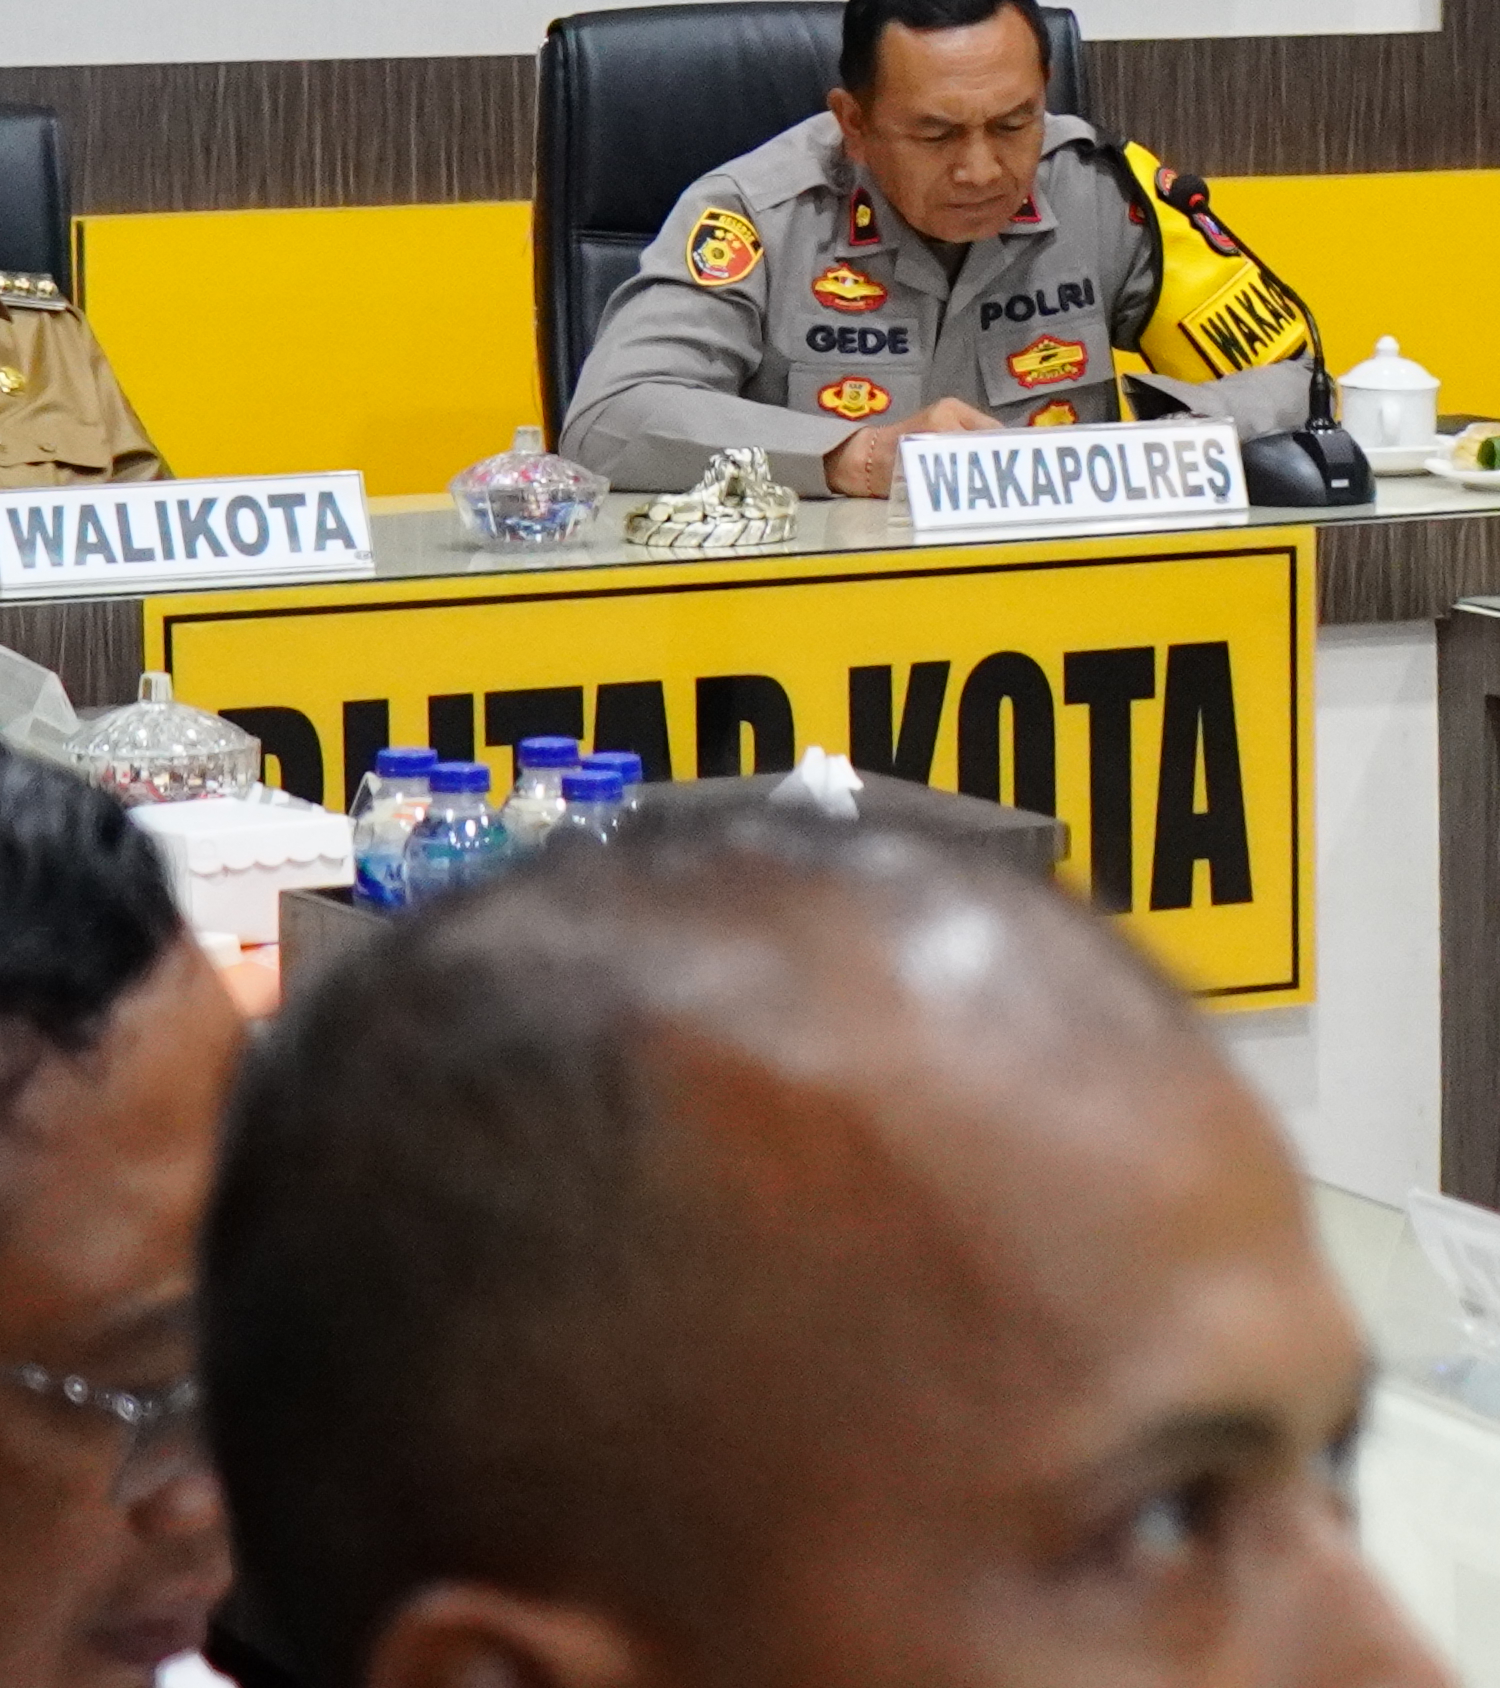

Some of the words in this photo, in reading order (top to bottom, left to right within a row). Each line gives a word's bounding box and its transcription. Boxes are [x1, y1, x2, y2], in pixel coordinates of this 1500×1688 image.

[980, 277, 1095, 331] POLRI
[805, 324, 910, 356] GEDE
[917, 437, 1234, 514] WAKAPOLRES
[5, 491, 360, 571] WALIKOTA
